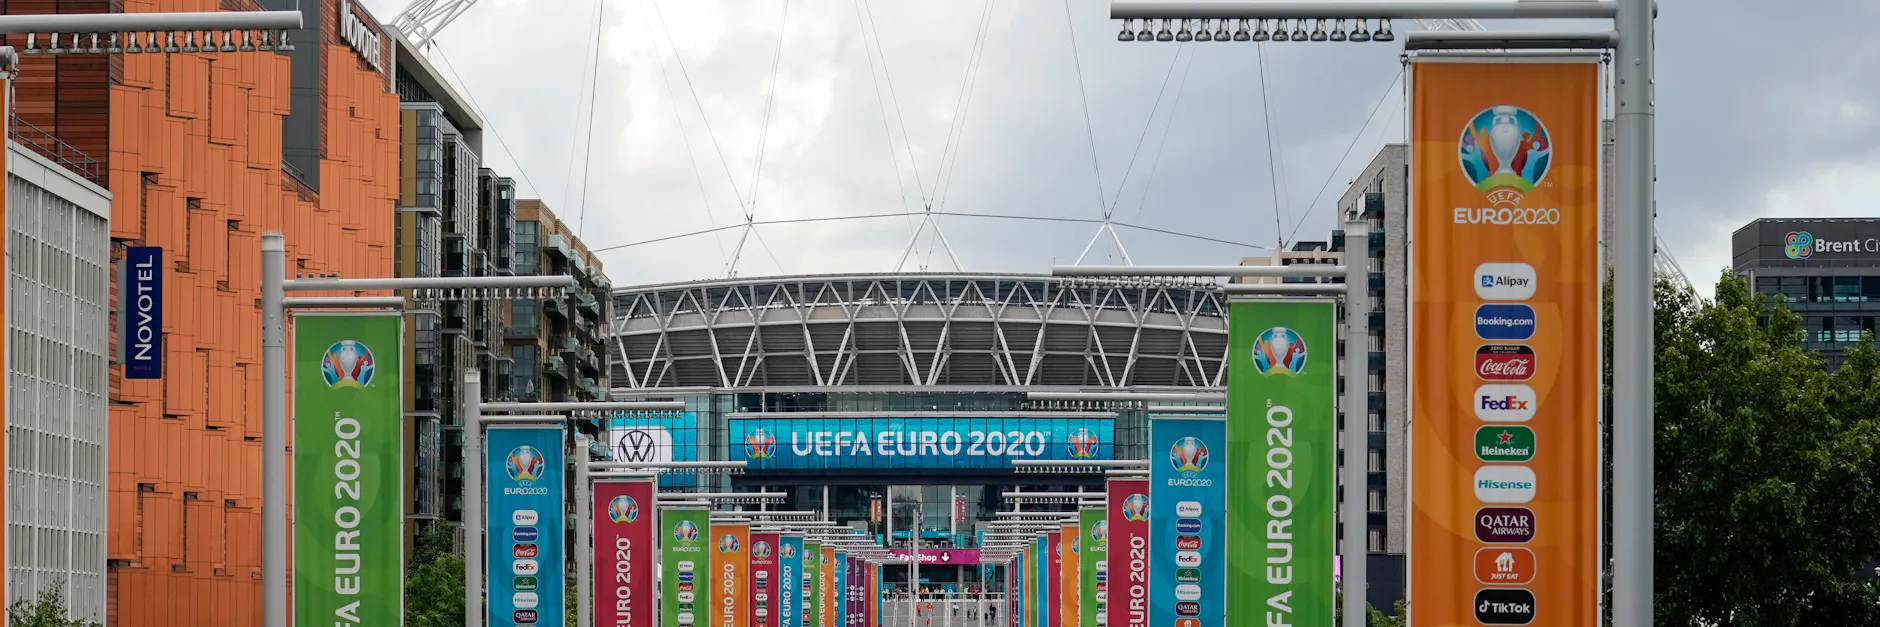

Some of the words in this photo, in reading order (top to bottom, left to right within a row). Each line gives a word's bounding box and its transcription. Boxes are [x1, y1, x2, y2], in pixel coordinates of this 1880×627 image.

[341, 0, 383, 73] NOVOTEL
[1487, 191, 1522, 205] UEFA
[1454, 207, 1561, 225] EURO2020
[1815, 238, 1861, 253] Brent
[1864, 238, 1880, 252] Ci
[1496, 276, 1529, 288] Alipay
[134, 254, 153, 361] NOVOTEL
[1477, 316, 1533, 327] Booking.com
[1481, 395, 1529, 411] FedEx
[791, 431, 872, 457] UEFA
[877, 430, 962, 456] EURO
[1481, 446, 1529, 456] Heineken
[1478, 480, 1532, 489] Hisense
[1480, 514, 1529, 529] QATAR
[1491, 527, 1530, 536] AIRWAYS
[1266, 494, 1293, 584] EURO
[334, 506, 361, 595] EURO
[515, 563, 535, 571] FedEx
[1177, 604, 1198, 612] QATAR
[1491, 603, 1531, 614] TikTok
